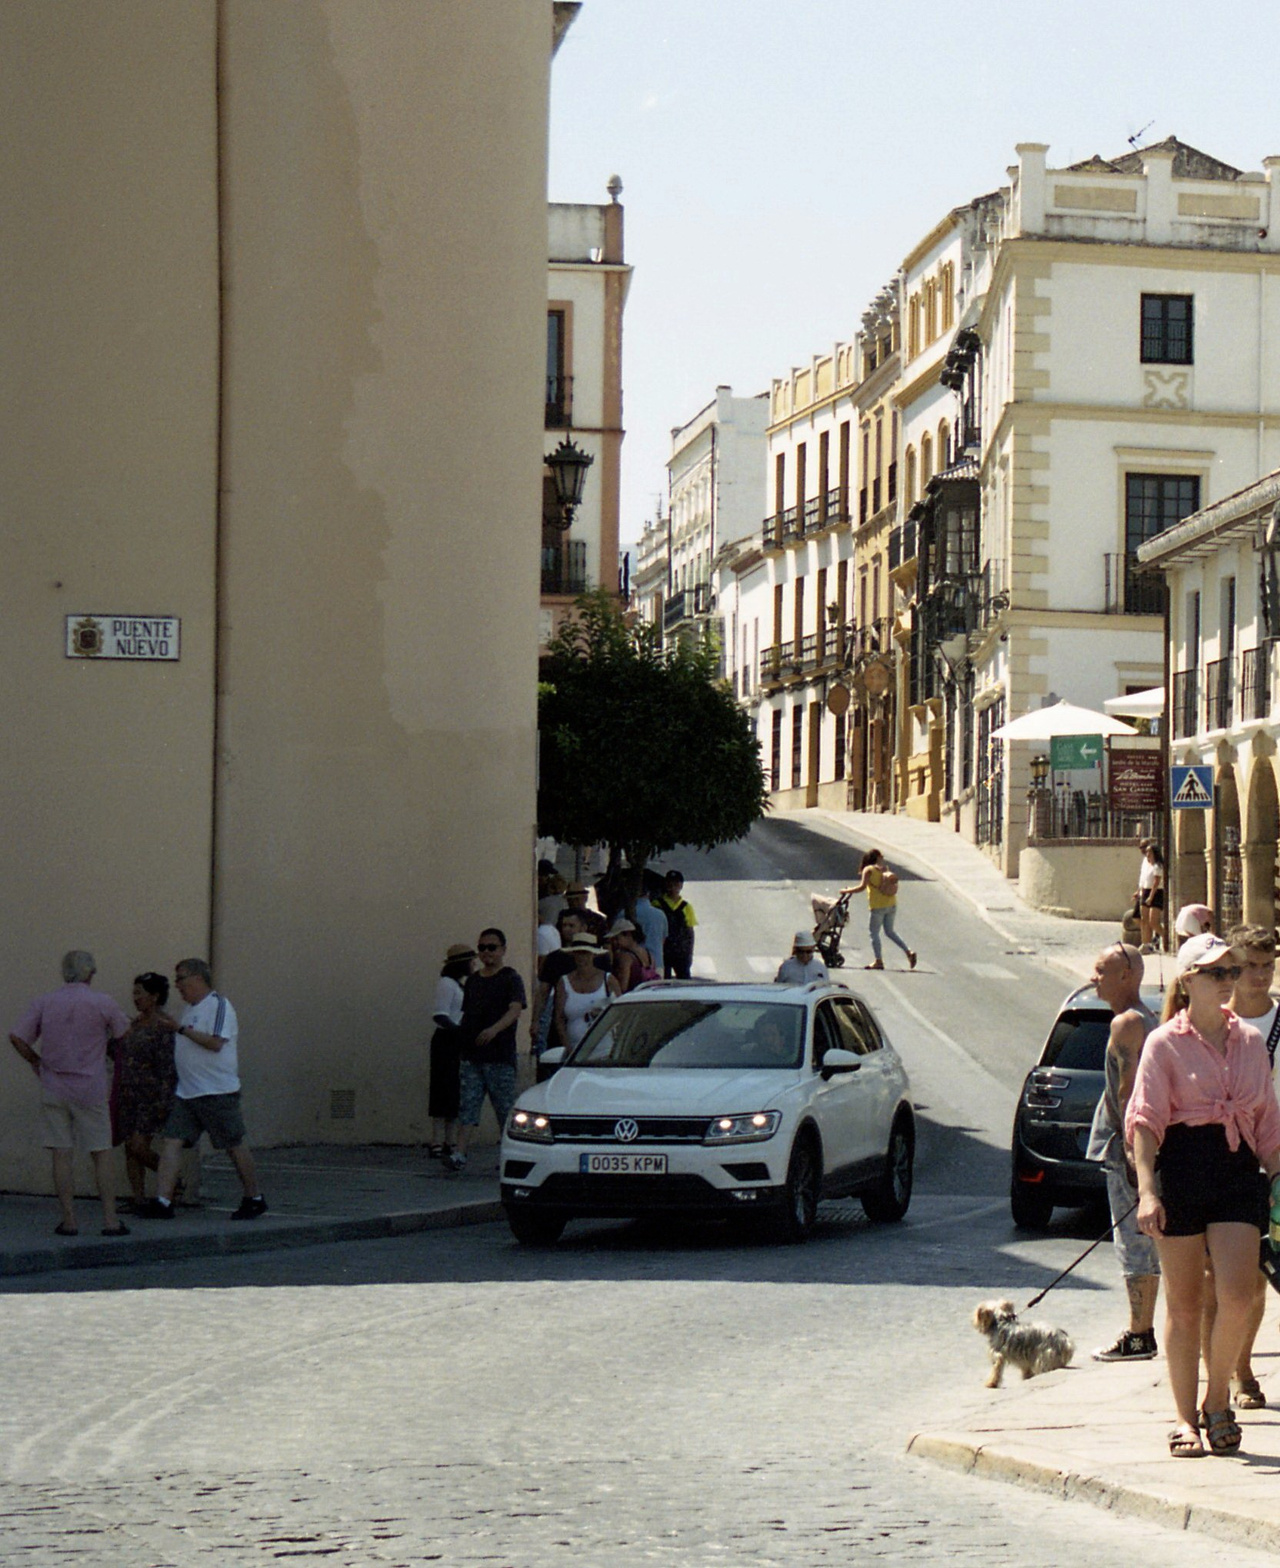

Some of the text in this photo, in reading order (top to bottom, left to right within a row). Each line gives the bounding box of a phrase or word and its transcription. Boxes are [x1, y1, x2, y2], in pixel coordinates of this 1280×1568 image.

[113, 620, 173, 638] PUENTE
[116, 639, 169, 656] NUEVO
[592, 1156, 663, 1171] 0035 KPM
